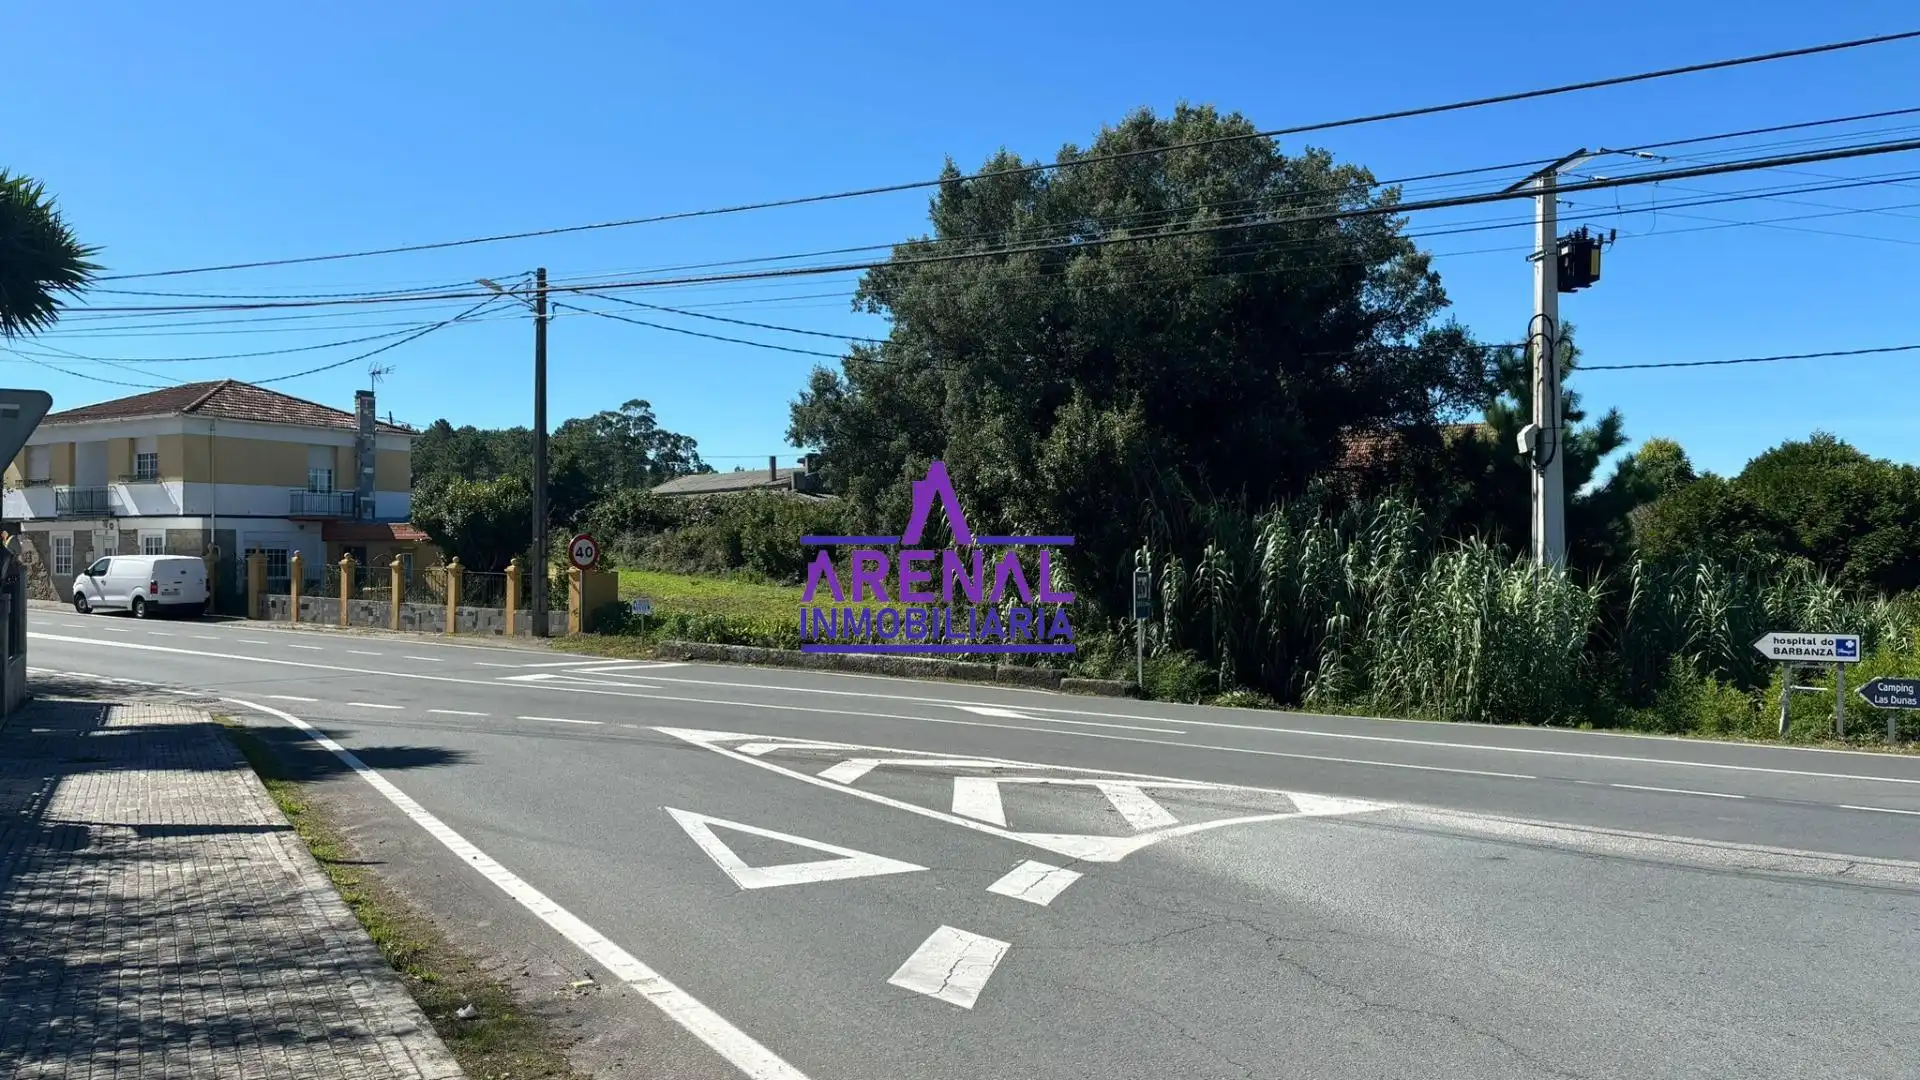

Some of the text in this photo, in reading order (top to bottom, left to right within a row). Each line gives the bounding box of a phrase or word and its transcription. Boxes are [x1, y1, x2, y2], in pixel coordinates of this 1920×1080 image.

[575, 546, 593, 558] 40
[1773, 637, 1834, 646] hospital do
[1773, 647, 1834, 657] BARBANZA
[1877, 682, 1914, 694] Camping
[1874, 695, 1917, 705] Las Dunas
